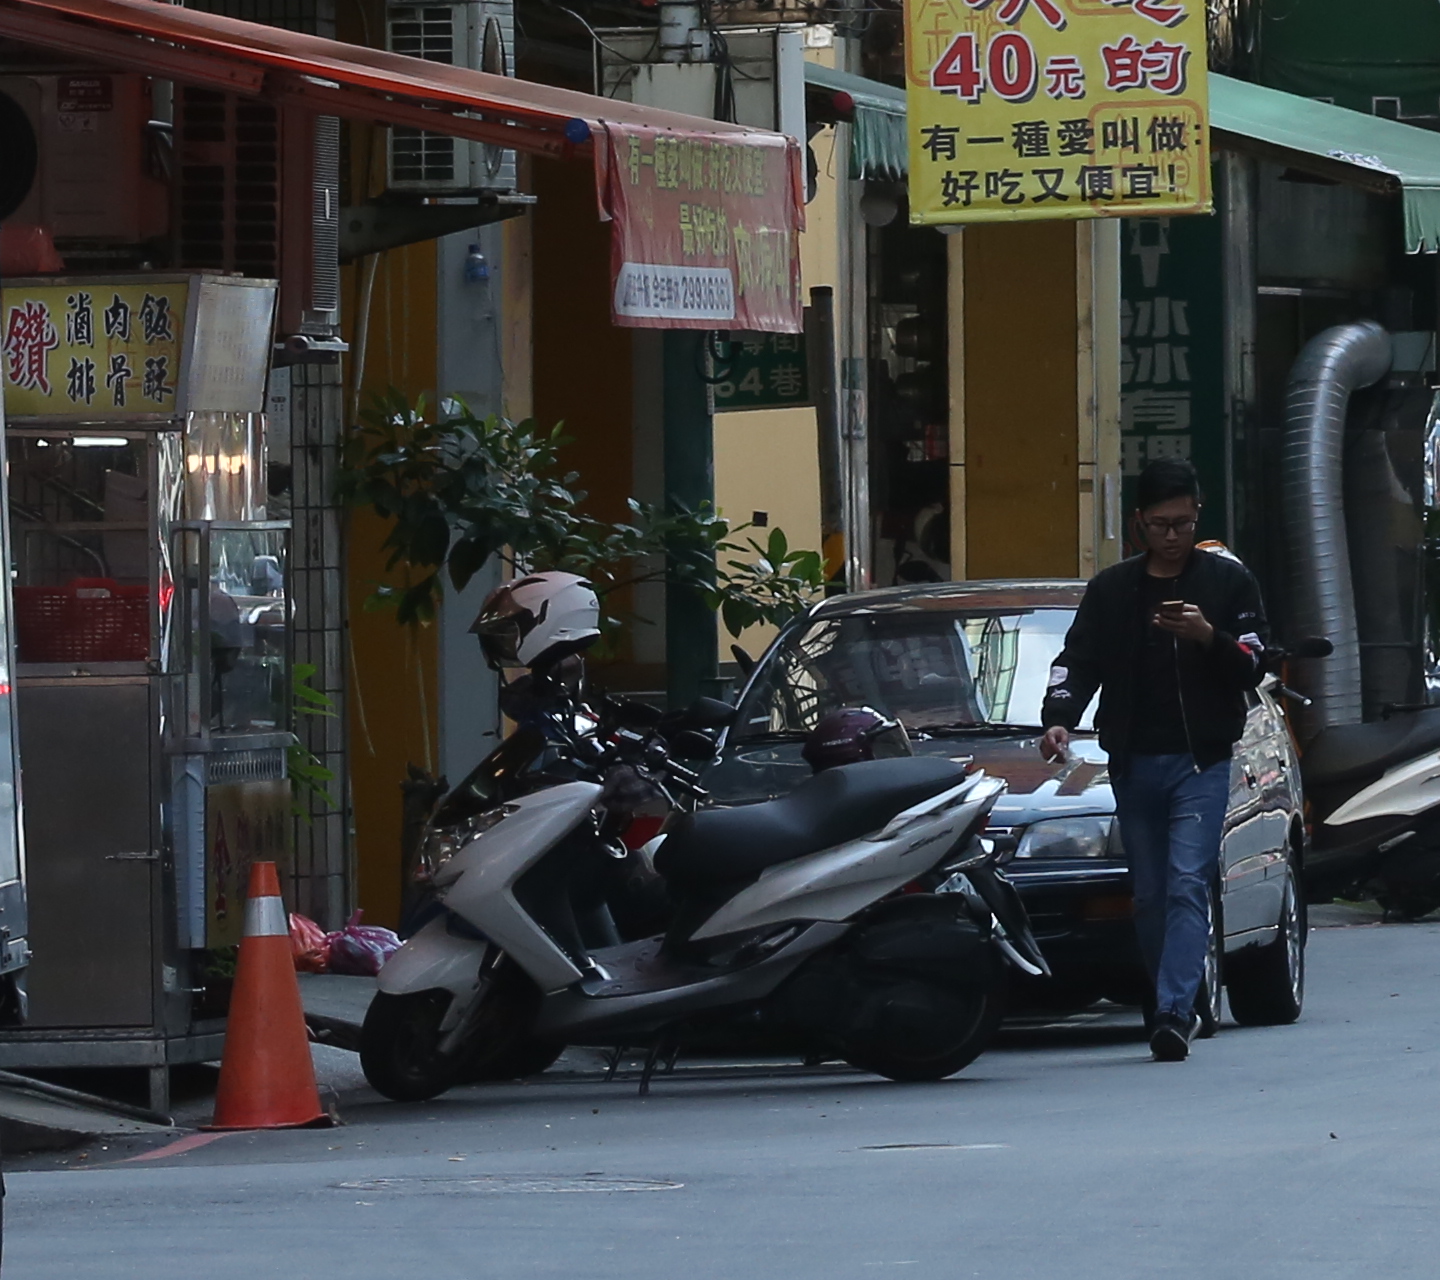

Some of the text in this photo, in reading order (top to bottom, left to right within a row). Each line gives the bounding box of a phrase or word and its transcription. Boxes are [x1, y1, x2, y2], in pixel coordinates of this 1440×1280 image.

[932, 32, 1085, 101] 40元
[921, 119, 1203, 161] 有一種愛叫做:
[941, 163, 1178, 207] 好吃又便宜!
[67, 292, 173, 345] 滷肉飯
[67, 355, 173, 407] 排骨酥
